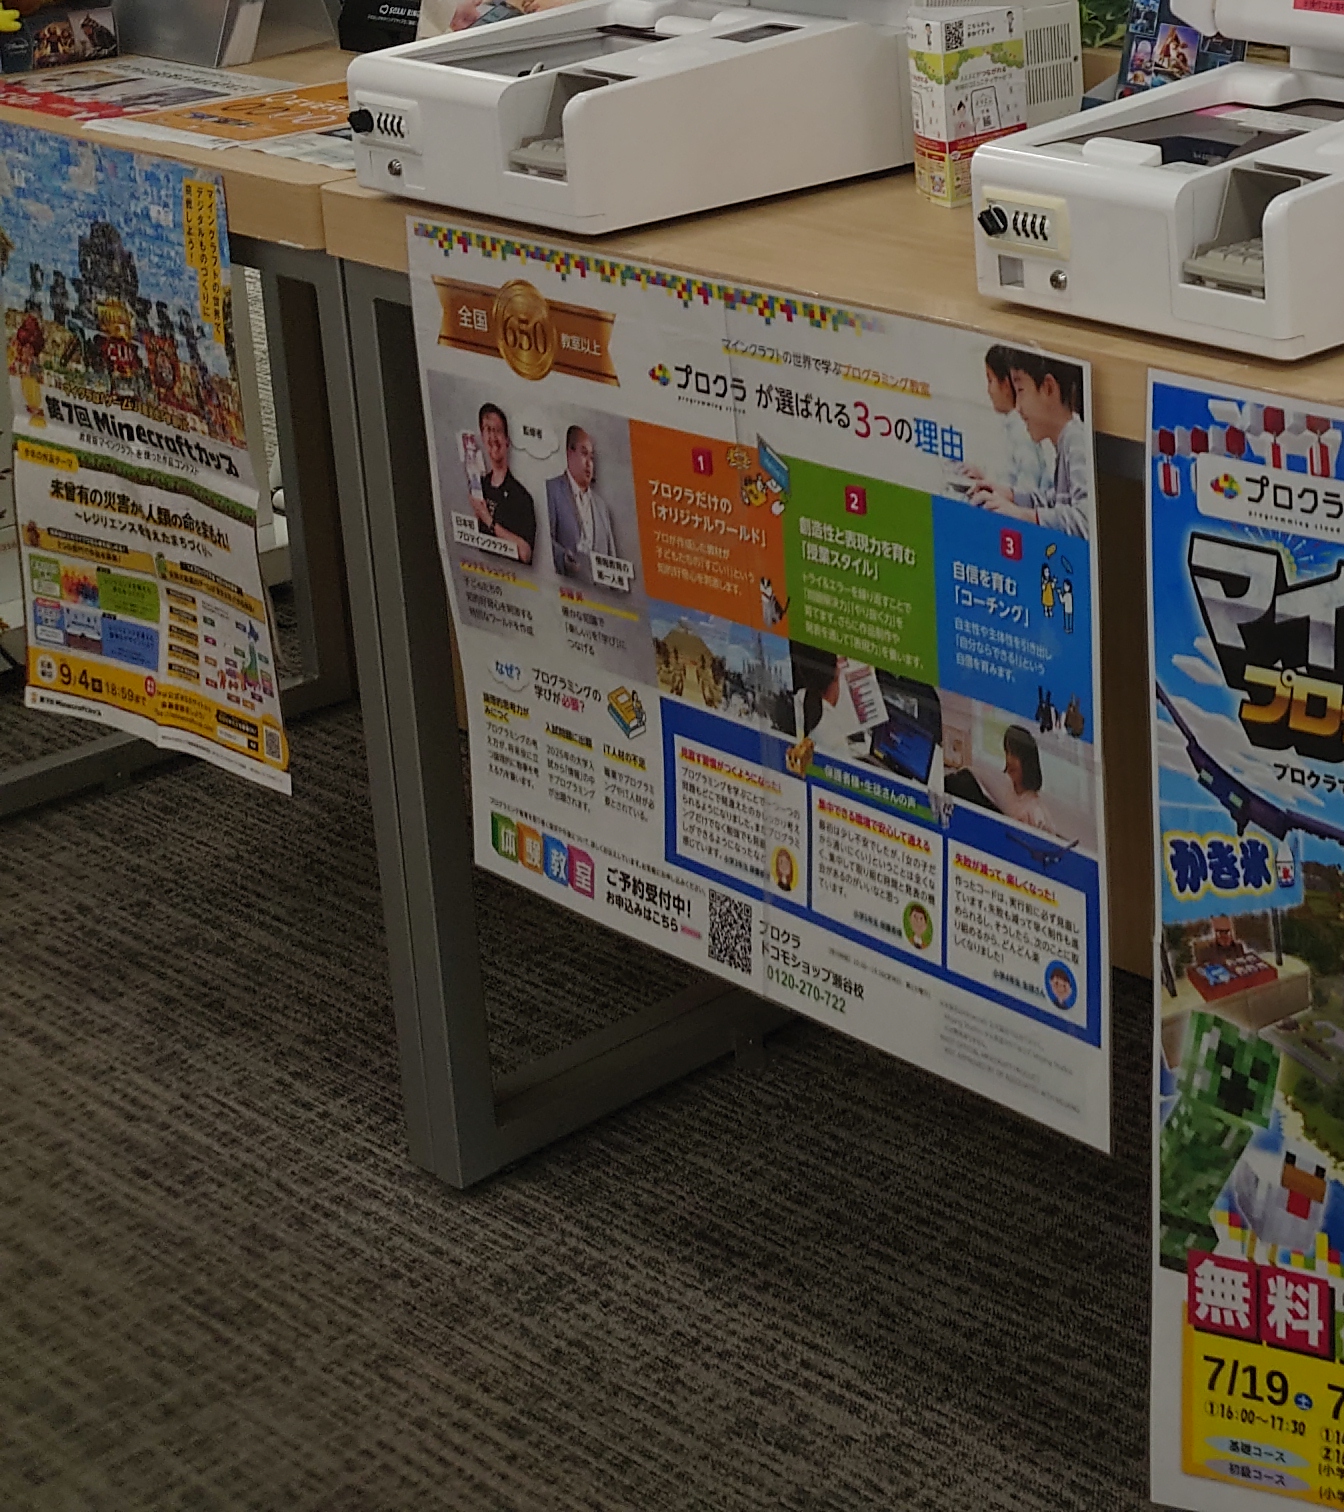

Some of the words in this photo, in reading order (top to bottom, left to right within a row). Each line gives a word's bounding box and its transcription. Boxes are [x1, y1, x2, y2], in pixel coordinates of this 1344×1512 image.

[458, 306, 488, 332] 全国
[502, 317, 548, 356] 650
[561, 333, 602, 356] 教室以上
[756, 384, 964, 463] が選ばれる3つの理由
[93, 409, 240, 479] Minecraftカップ
[697, 455, 706, 471] 1
[850, 492, 859, 511] 2
[1248, 510, 1310, 530] programming
[651, 500, 767, 547] 「オリジナルワールド」
[799, 516, 916, 567] 創造性と表現力を育む
[1004, 538, 1014, 555] 3
[953, 560, 1017, 597] 自信を育む
[954, 588, 1030, 628] 「コーチング」
[494, 659, 521, 681] なぜ?
[532, 668, 602, 703] プログラミングの
[534, 685, 585, 714] 学びが必要?
[497, 827, 594, 899] 体験教室
[1169, 838, 1272, 894] かき氷
[606, 866, 692, 919] ご予約受付中!
[606, 890, 679, 934] お申込みはこちら
[760, 940, 865, 1001] ドコモショップ瀬谷校
[765, 963, 847, 1016] 0120-270-722
[1194, 1259, 1324, 1349] 無料
[1203, 1354, 1289, 1406] 7/19
[1228, 1439, 1287, 1464] 基礎コース
[1228, 1463, 1286, 1487] 初級コース
